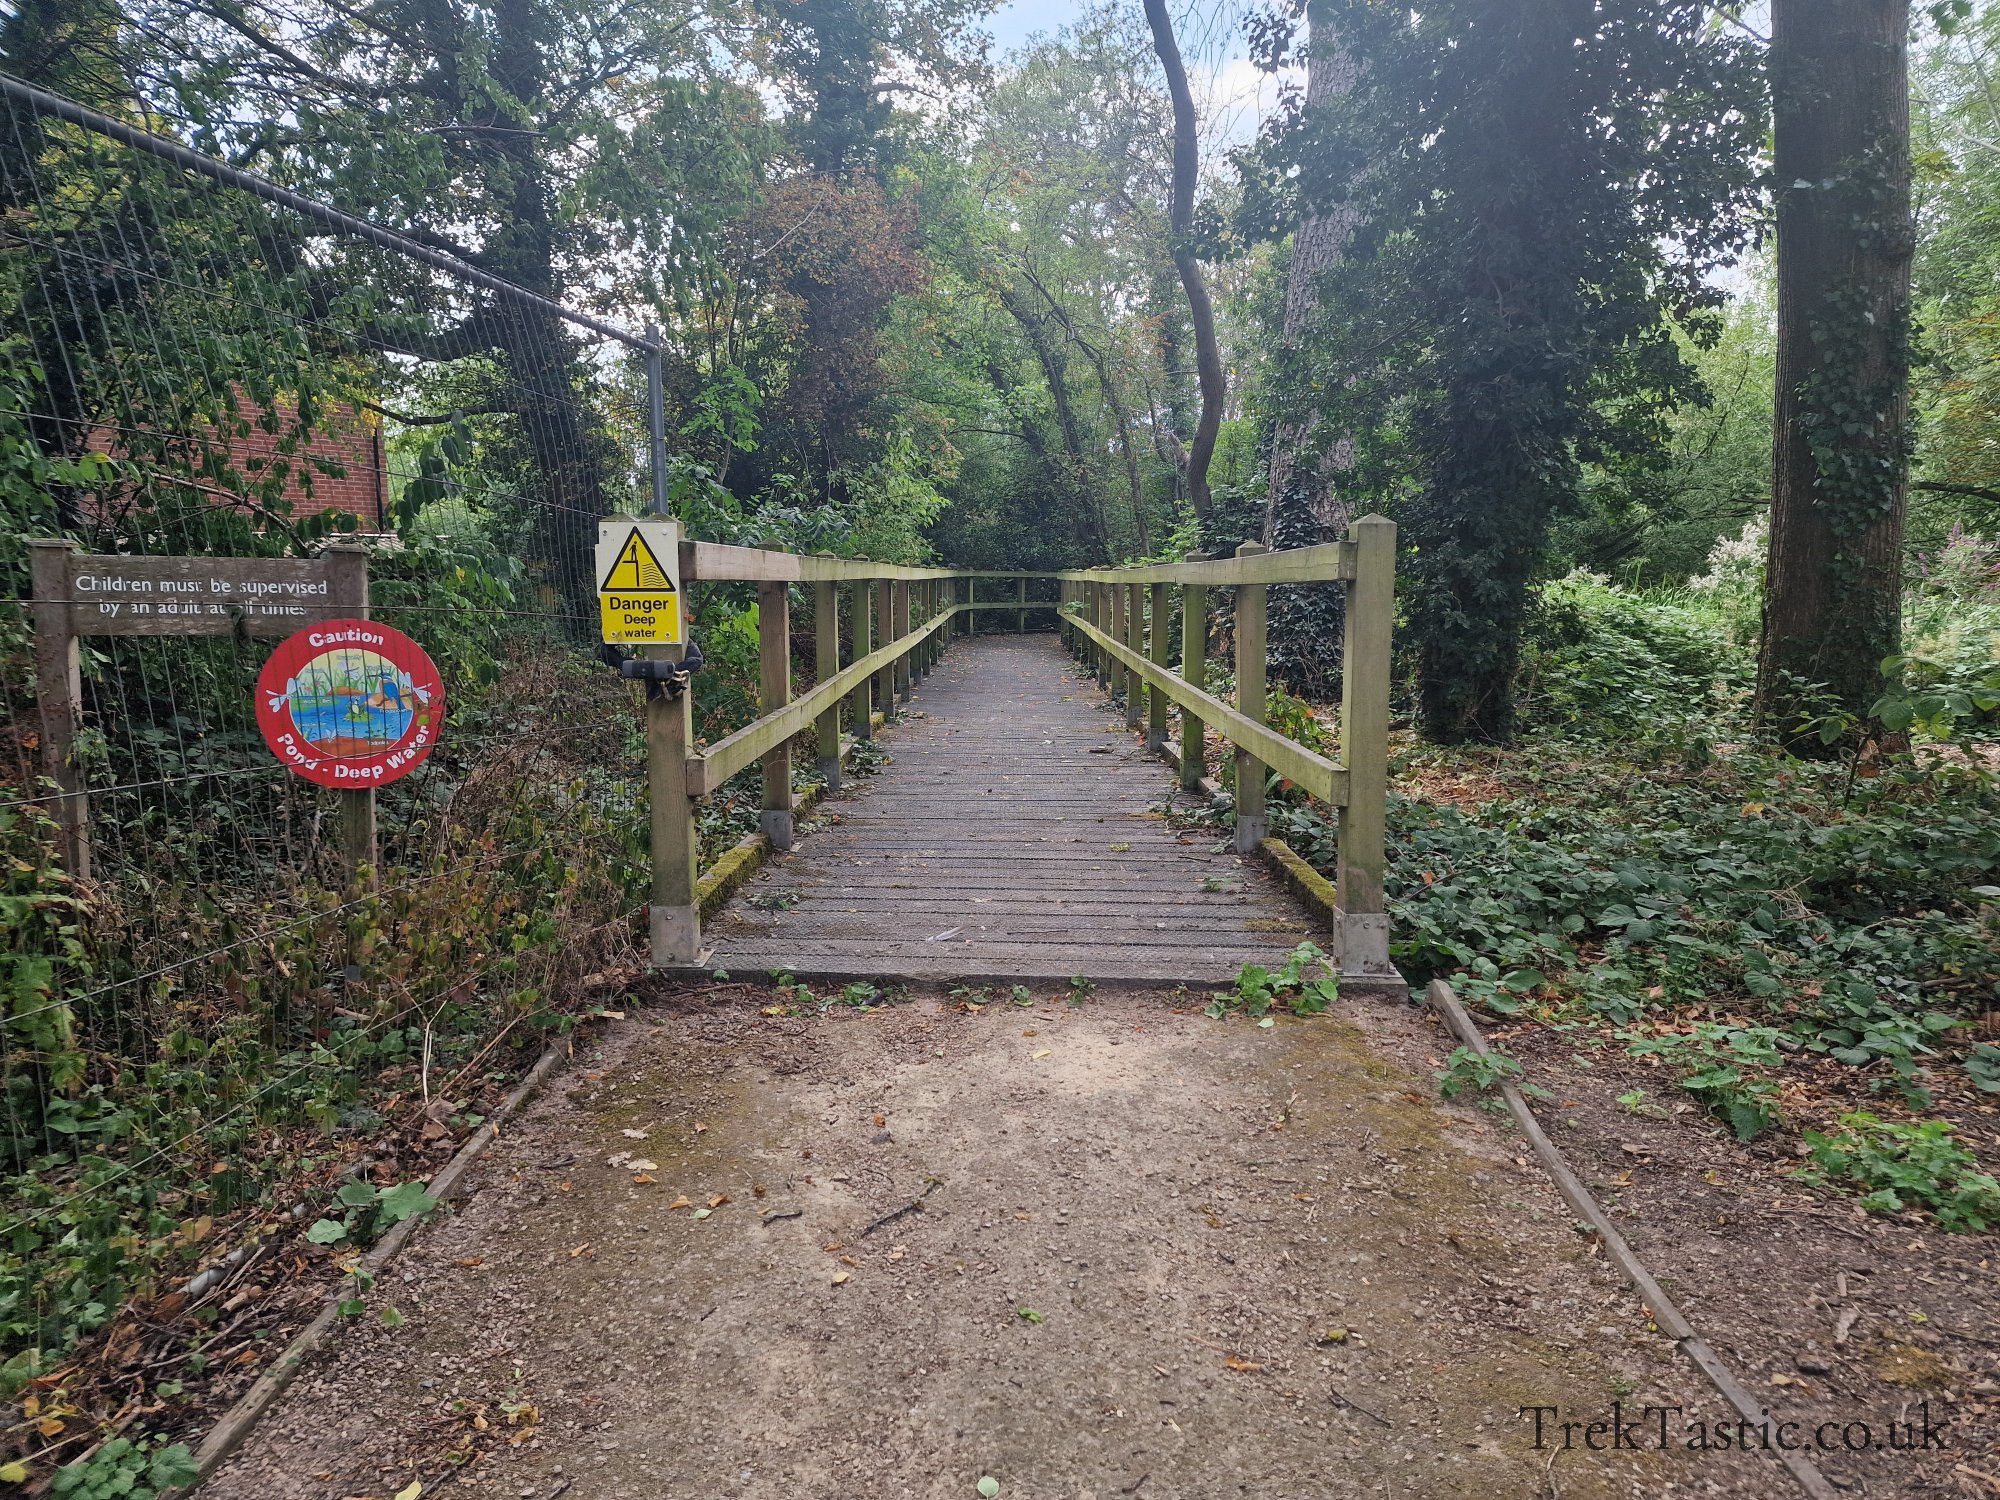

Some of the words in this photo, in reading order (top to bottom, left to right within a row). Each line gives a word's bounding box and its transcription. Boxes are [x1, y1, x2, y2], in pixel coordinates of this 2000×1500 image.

[75, 575, 152, 592] Children
[159, 578, 203, 592] must
[210, 578, 231, 593] be
[239, 579, 328, 597] supervised
[99, 599, 120, 618] by
[131, 603, 150, 614] an
[157, 600, 202, 615] adult
[209, 602, 227, 615] at
[261, 601, 307, 616] times
[609, 596, 669, 613] Danger
[624, 614, 656, 627] Deep
[309, 628, 384, 647] Caution
[624, 629, 656, 638] water
[277, 733, 320, 770] Pond
[334, 764, 384, 779] Deep
[386, 725, 430, 769] Water
